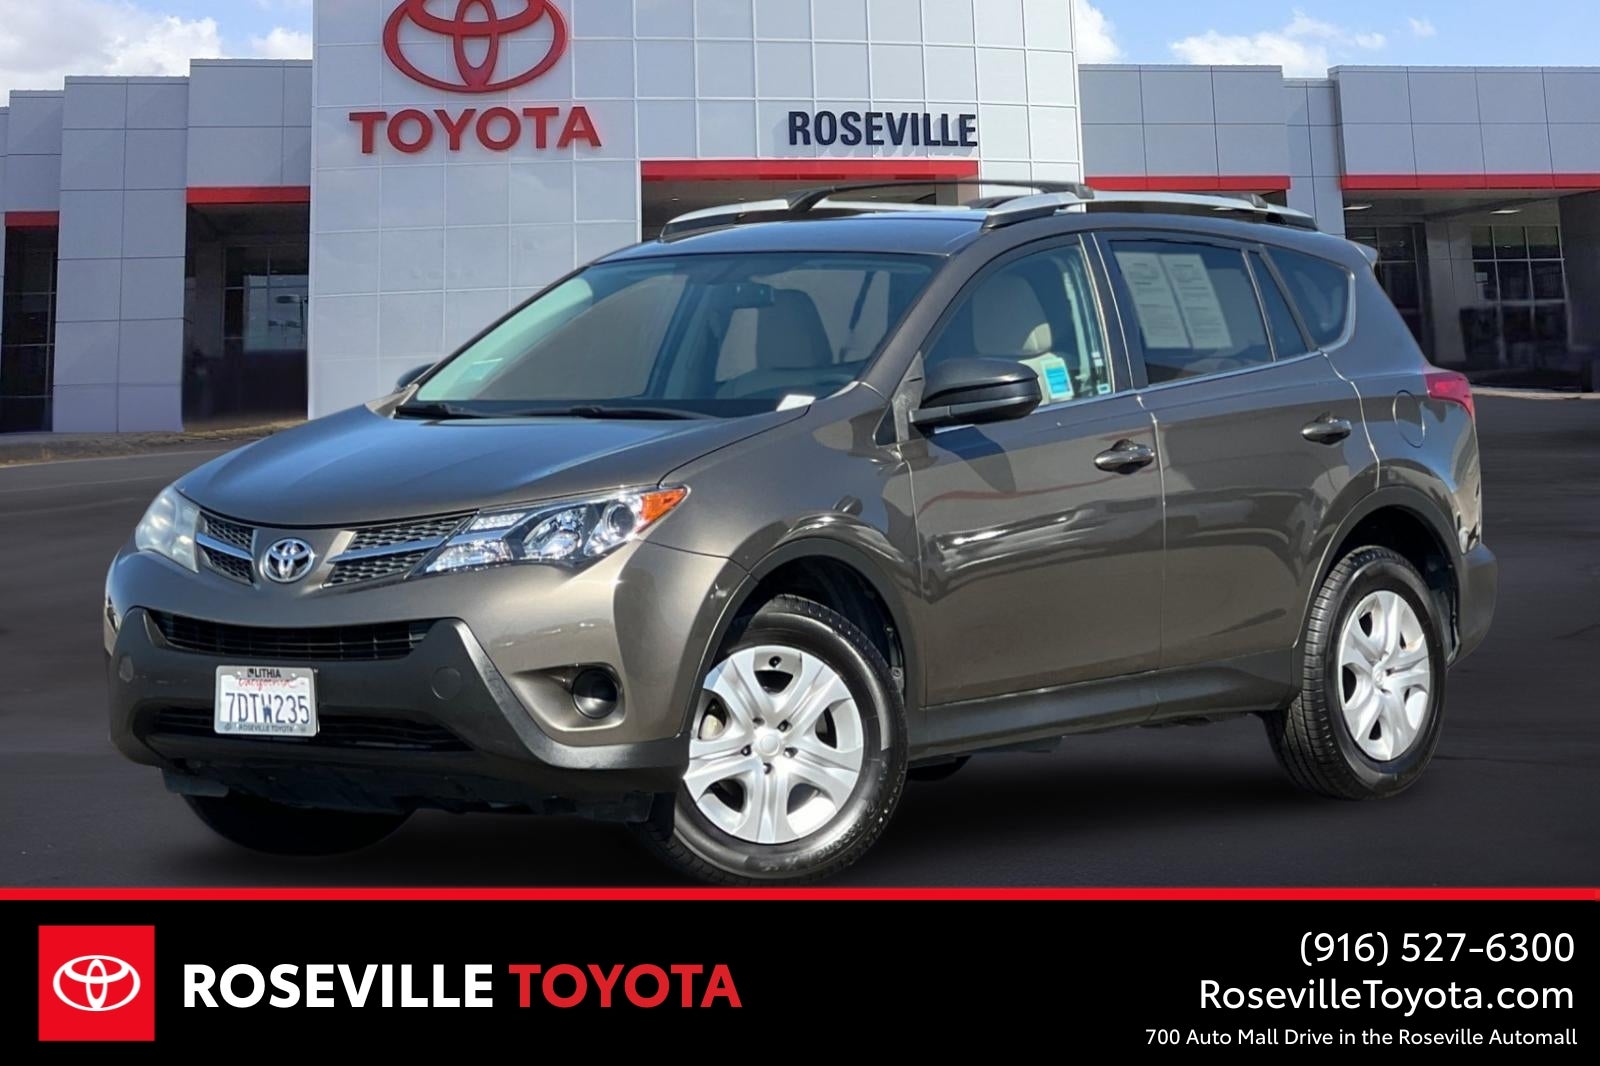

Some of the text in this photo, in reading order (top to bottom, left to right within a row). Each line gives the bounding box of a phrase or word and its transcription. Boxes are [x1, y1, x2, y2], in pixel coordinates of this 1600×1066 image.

[349, 107, 602, 154] TOYOTA
[788, 110, 978, 147] ROSEVILLE
[254, 668, 282, 678] LITHIA
[225, 692, 310, 724] 7DTW235
